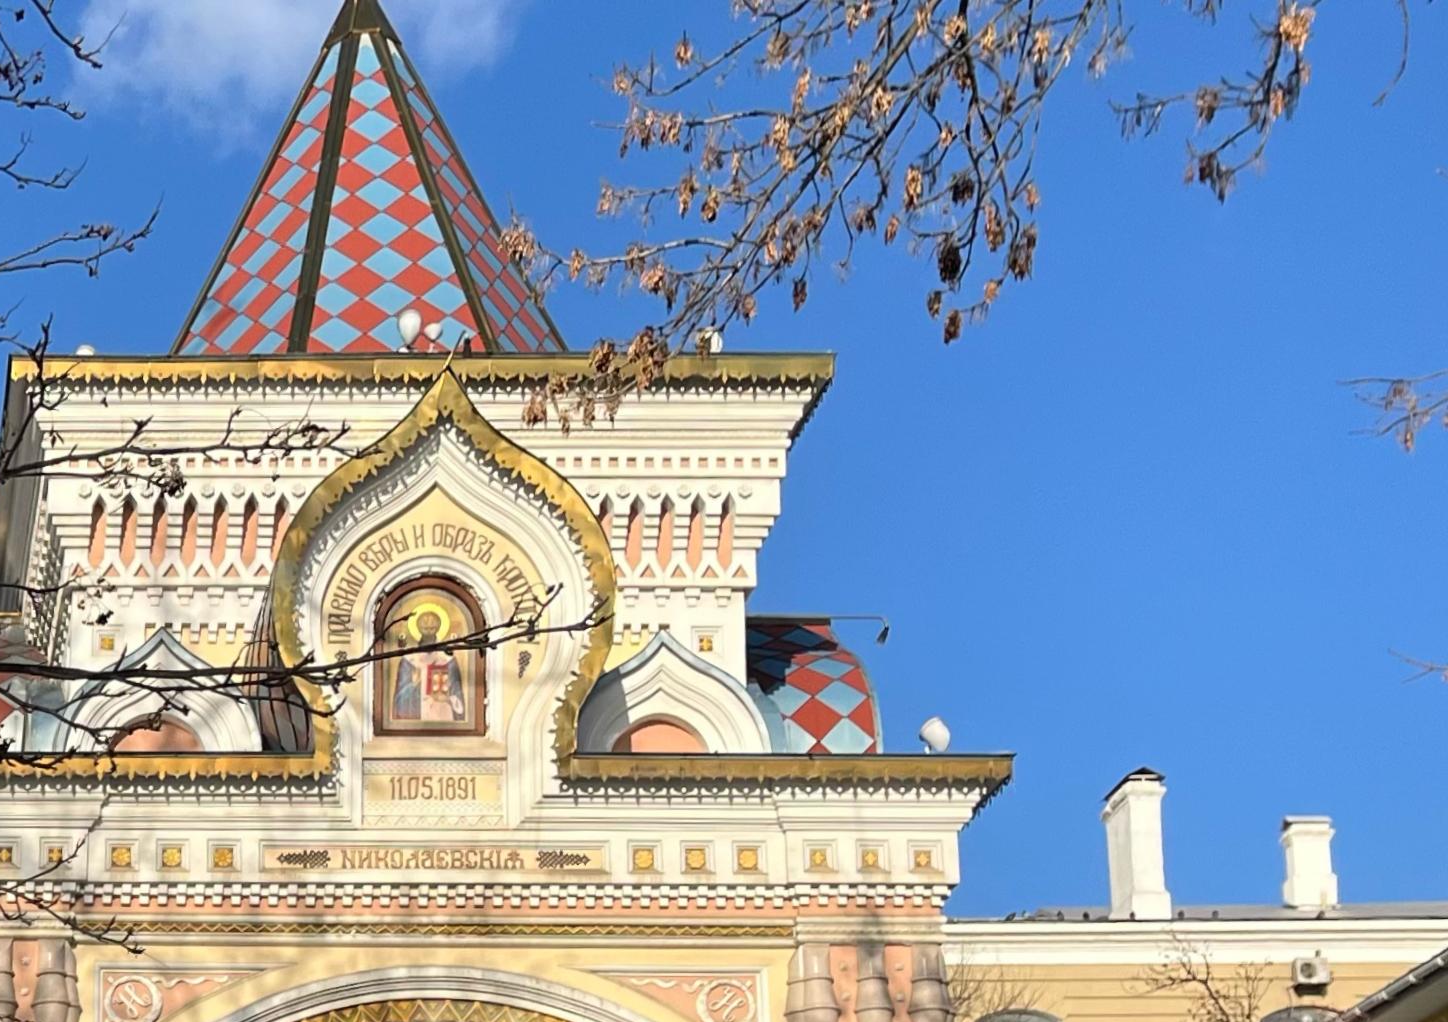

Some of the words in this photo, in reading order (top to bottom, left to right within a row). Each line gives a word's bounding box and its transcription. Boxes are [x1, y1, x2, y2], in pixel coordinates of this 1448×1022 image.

[327, 563, 367, 645] ПРАВИЛО
[412, 523, 426, 549] И
[432, 522, 496, 565] ОБРАЗЪ
[388, 776, 478, 801] 11.05.1891
